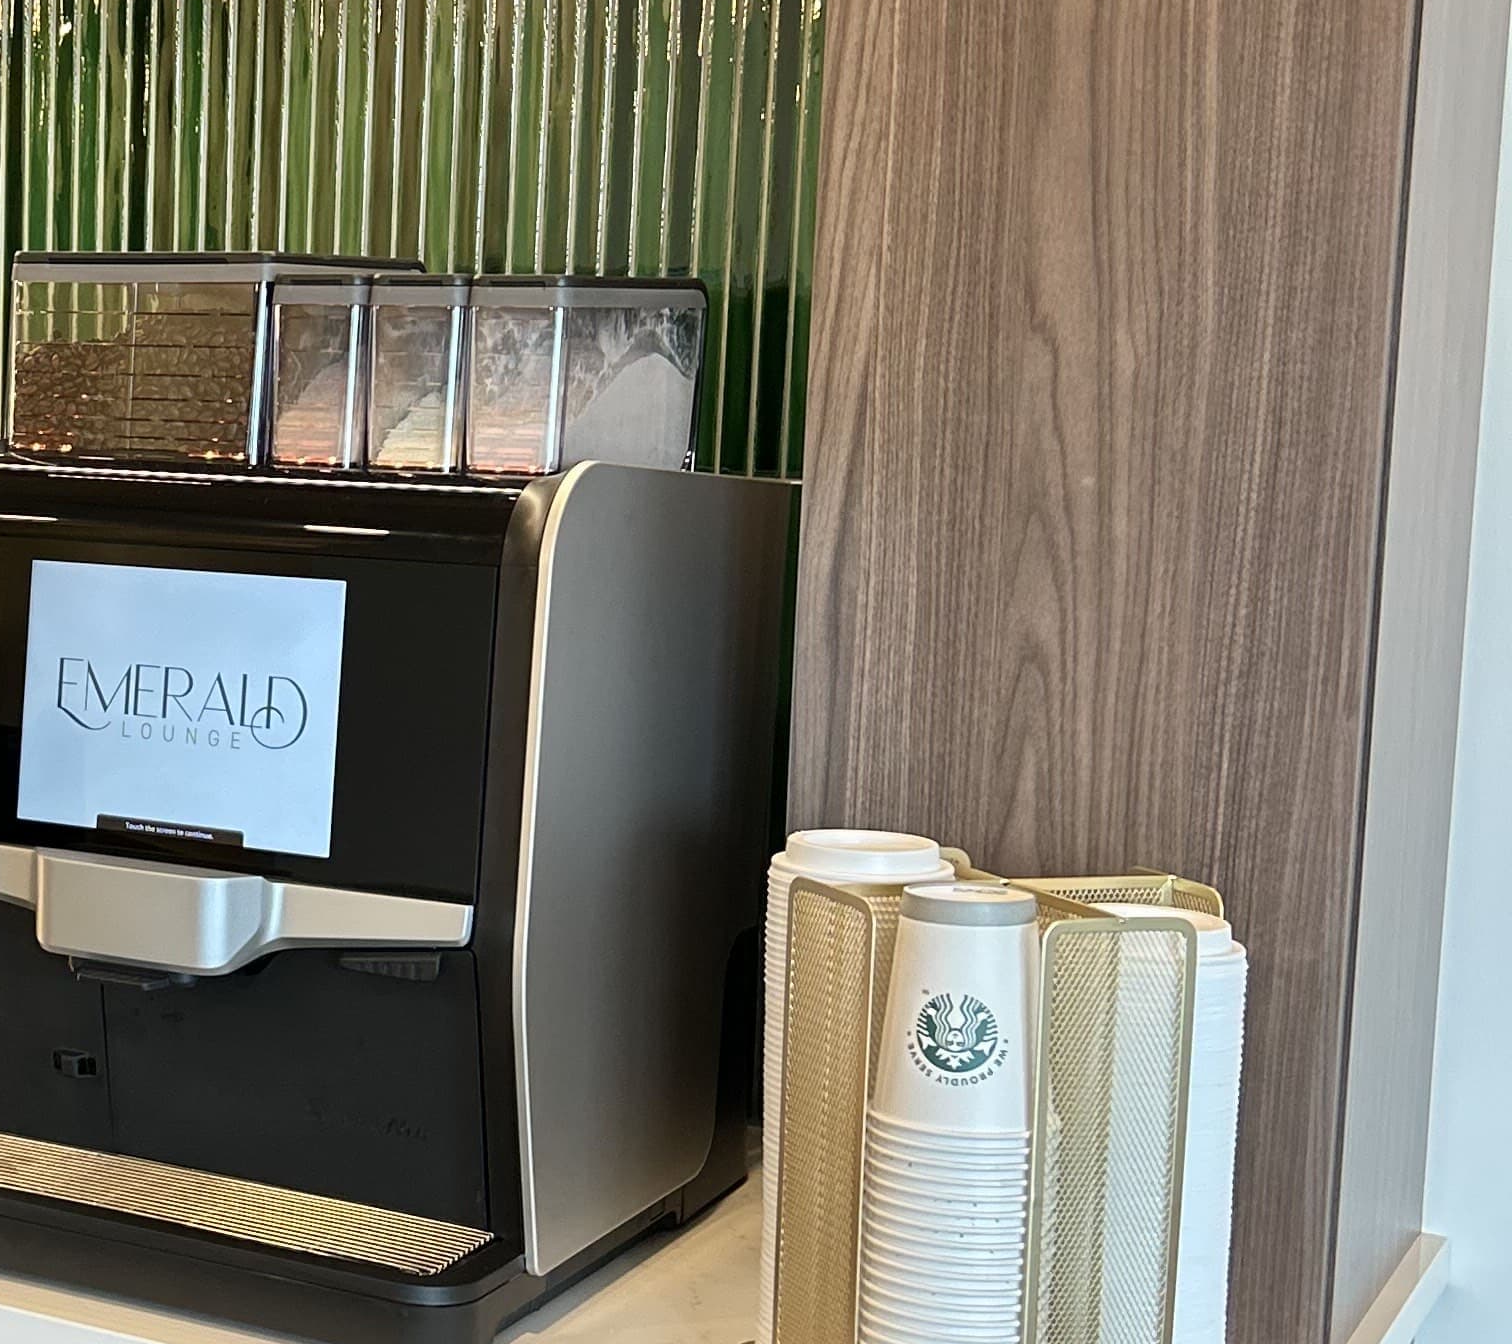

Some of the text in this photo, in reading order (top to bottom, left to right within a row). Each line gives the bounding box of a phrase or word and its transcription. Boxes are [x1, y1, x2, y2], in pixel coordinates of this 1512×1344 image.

[56, 656, 309, 750] EMERALD
[120, 721, 241, 750] LOUNGE
[145, 824, 156, 833] the
[907, 1042, 1009, 1087] WE PROUDLY SERVE
